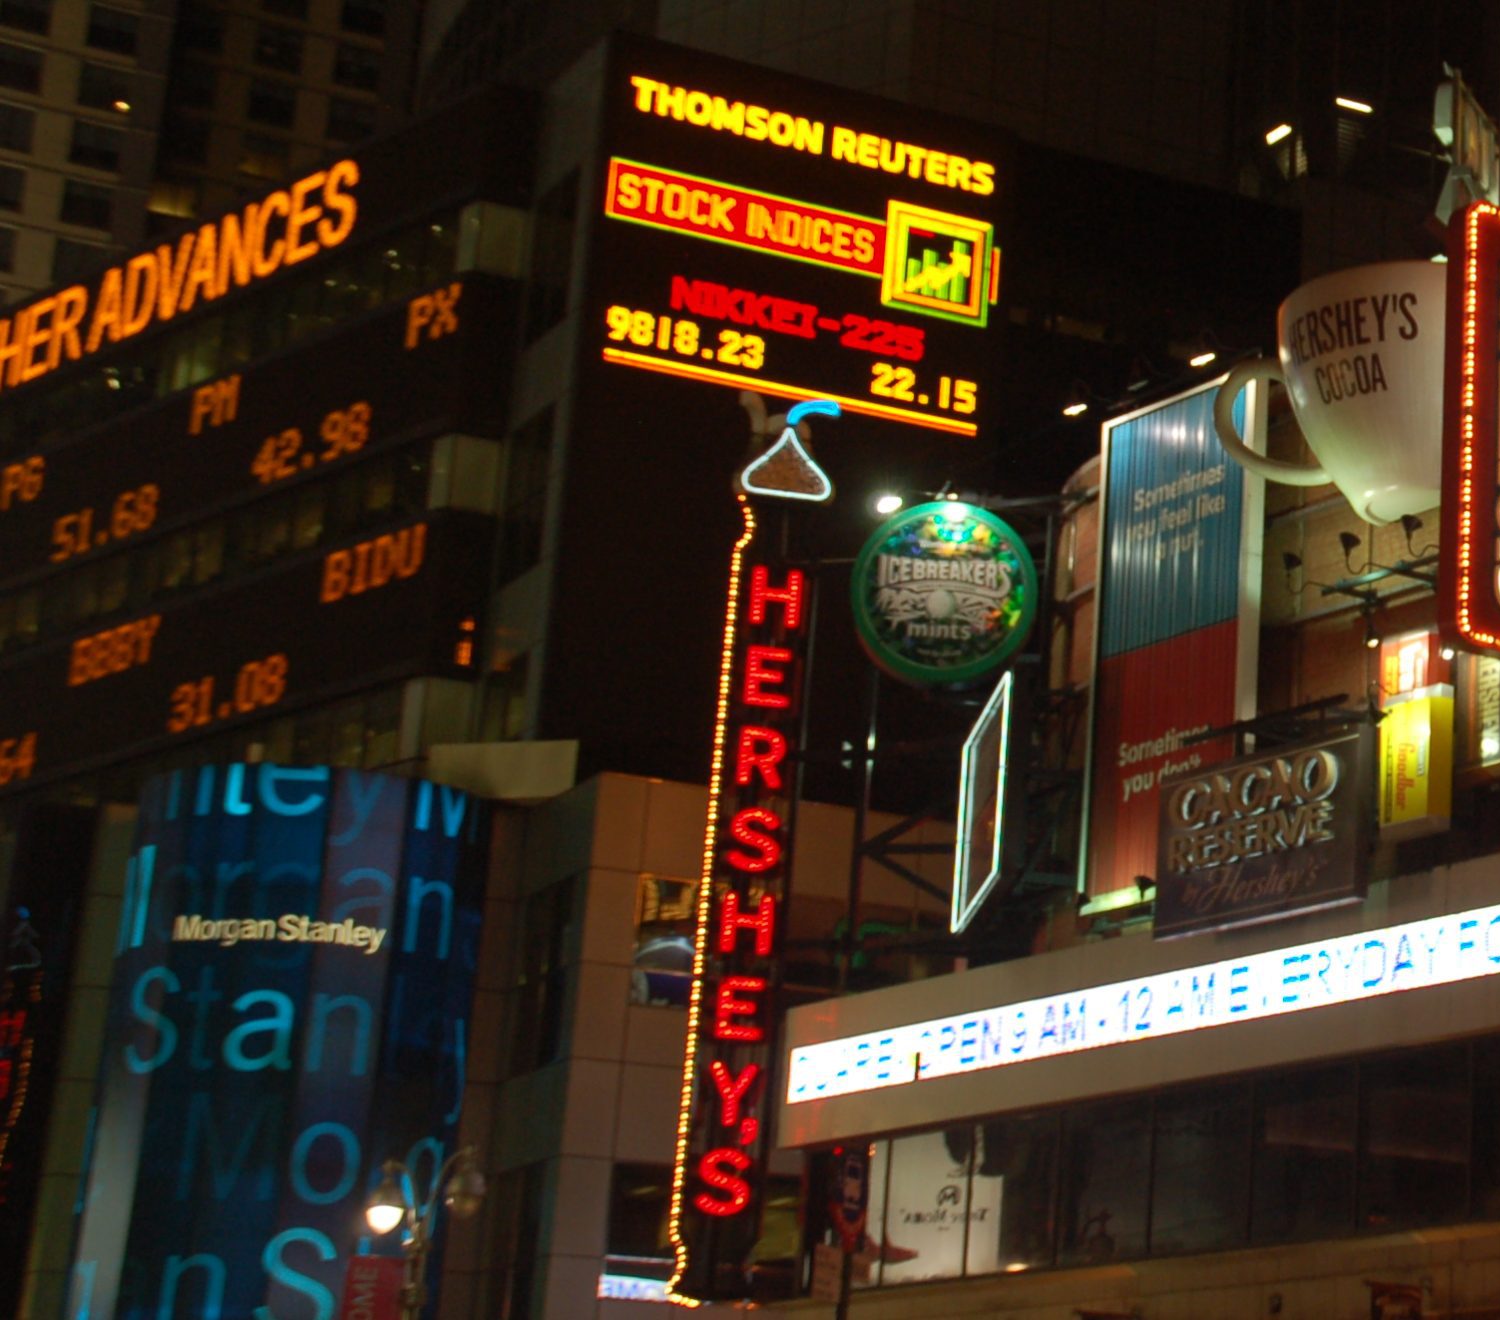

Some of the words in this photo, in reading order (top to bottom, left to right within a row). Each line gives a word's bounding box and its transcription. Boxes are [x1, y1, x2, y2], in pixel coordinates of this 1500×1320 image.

[630, 74, 825, 155] THOMSON
[831, 125, 996, 196] REUTERS
[85, 159, 361, 354] ADVANCES
[616, 172, 738, 233] STOCK
[744, 203, 877, 264] INDICES
[405, 282, 463, 351] PX
[669, 274, 926, 363] NIKKEI-225
[1288, 291, 1419, 371] HERSHEY'S
[605, 304, 767, 371] 9818.23
[870, 361, 979, 414] 22.15
[1315, 352, 1388, 406] COCOA
[249, 401, 373, 486] 42.98
[320, 522, 428, 602] BIDU
[907, 618, 973, 641] mints
[1122, 769, 1156, 803] you
[1168, 750, 1340, 831] CACAO
[1167, 800, 1336, 875] RESERVE
[694, 564, 805, 1218] HERSHEY'S
[171, 914, 275, 947] Morgan
[277, 914, 389, 956] Stanley
[1036, 1000, 1089, 1050] AM
[1118, 985, 1156, 1035] 12
[1228, 927, 1446, 1014] EERYDAY
